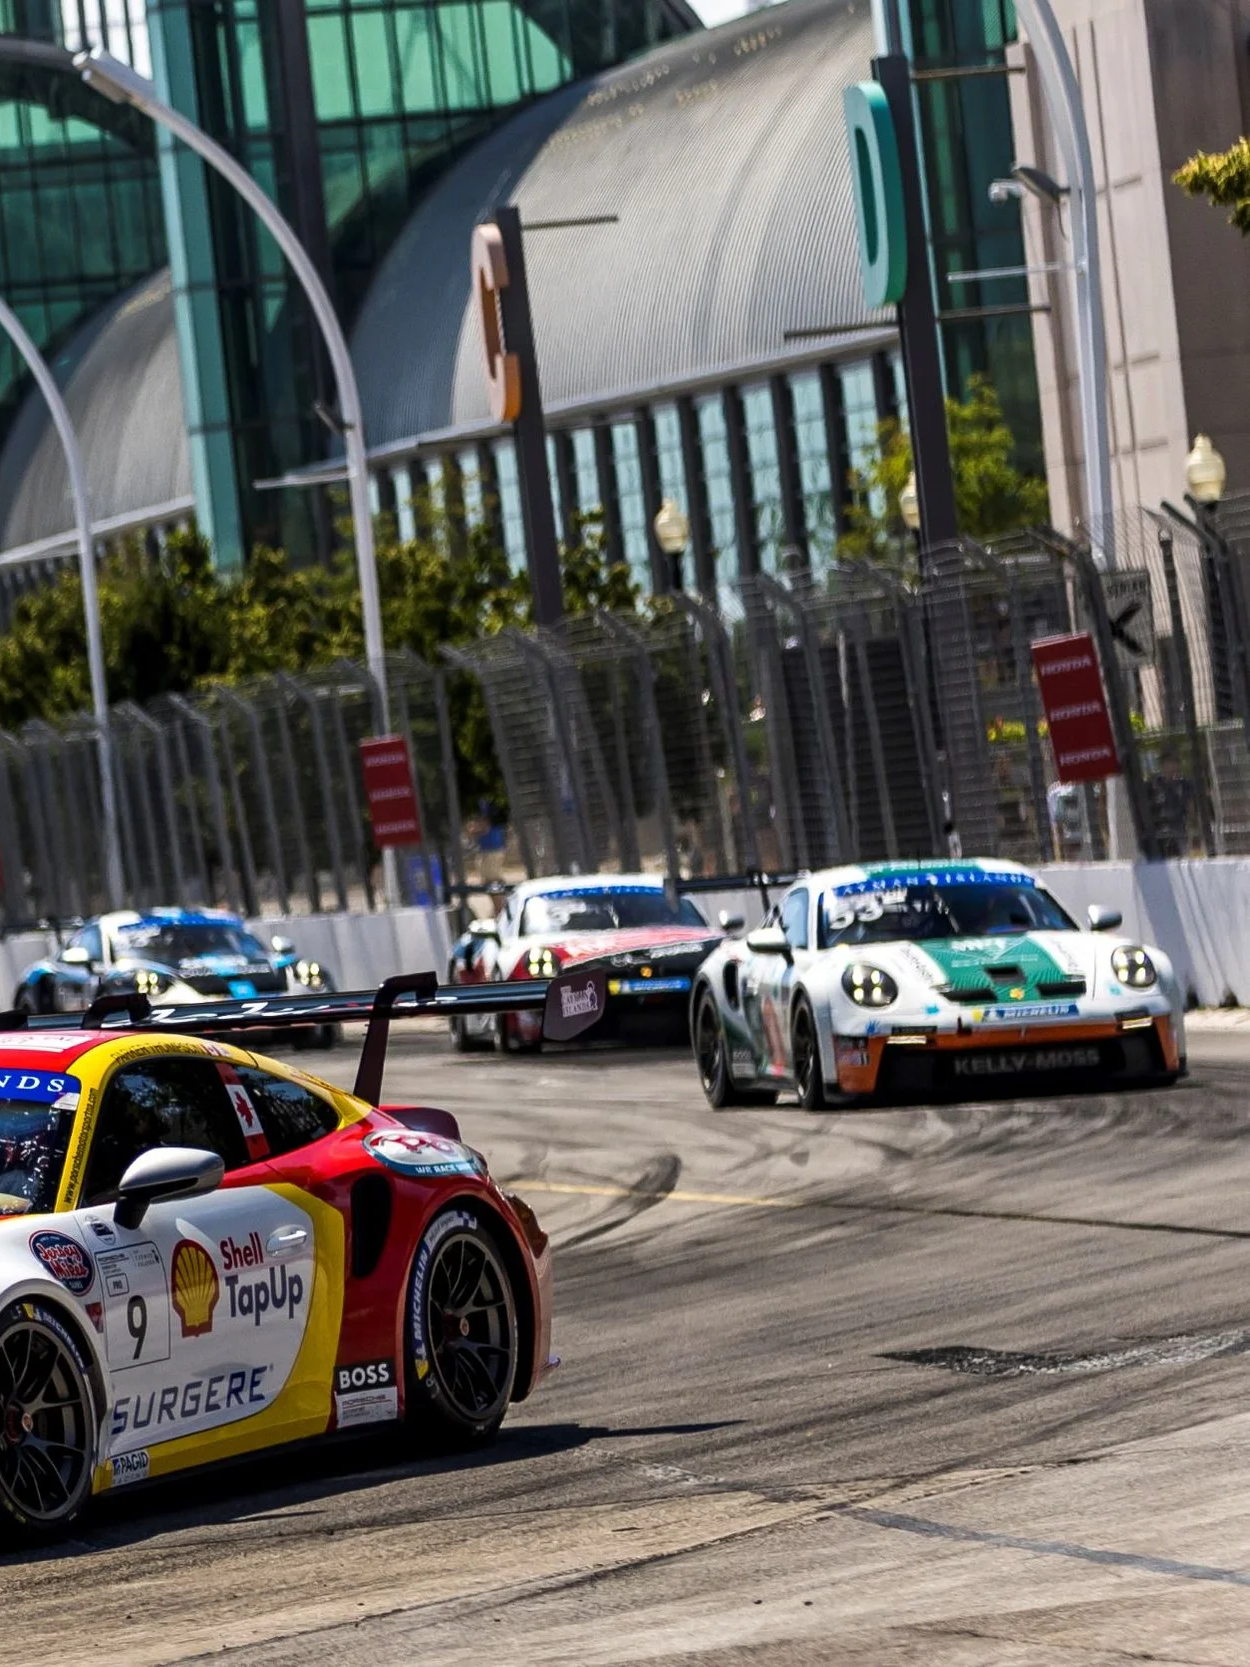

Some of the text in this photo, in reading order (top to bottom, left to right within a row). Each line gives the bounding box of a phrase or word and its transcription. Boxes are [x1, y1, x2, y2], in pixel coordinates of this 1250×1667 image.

[954, 1047, 1101, 1075] KELLY-MOSS
[35, 1242, 82, 1263] Jersey
[219, 1231, 264, 1271] Shell
[224, 1264, 304, 1327] TapUp
[414, 1250, 429, 1339] MICHELIN
[41, 1310, 86, 1372] MICHELIN
[127, 1295, 148, 1360] 9
[111, 1365, 268, 1436] SURGERE
[339, 1363, 390, 1390] BOSS
[120, 1451, 149, 1475] PAGID
